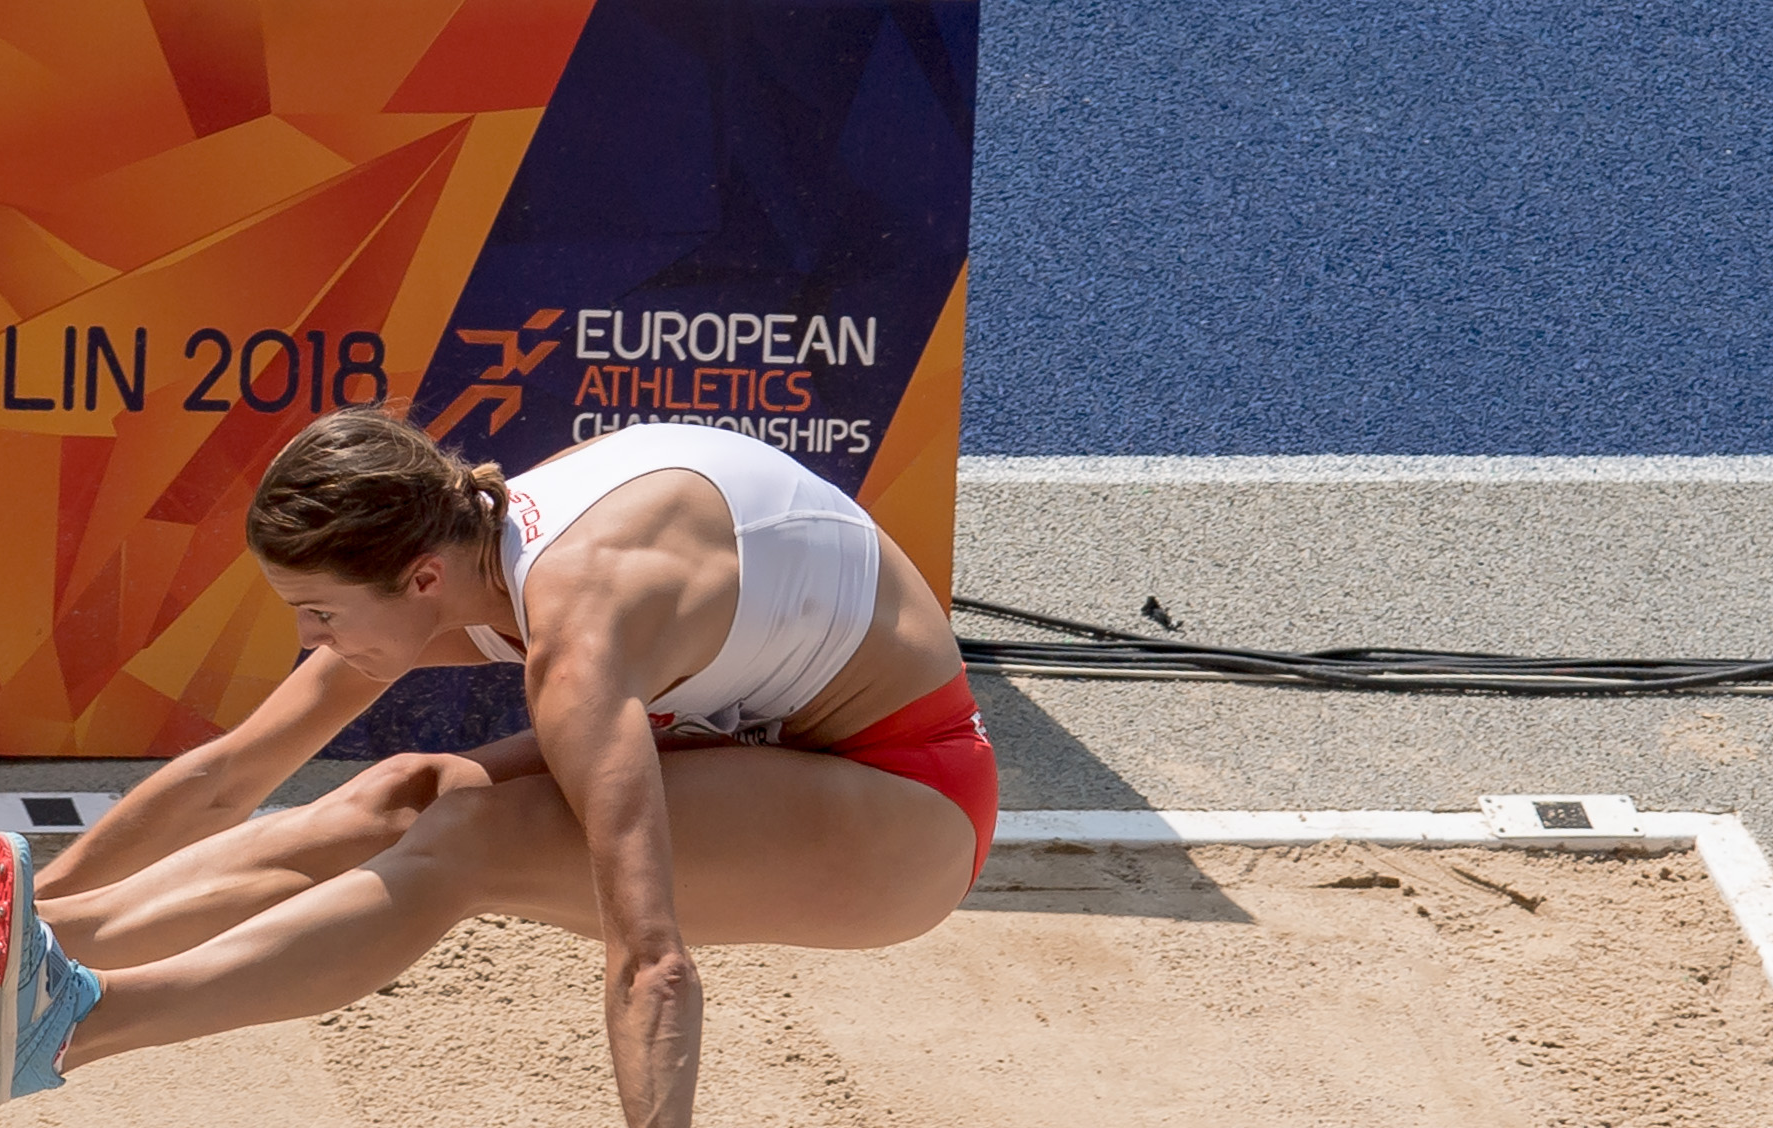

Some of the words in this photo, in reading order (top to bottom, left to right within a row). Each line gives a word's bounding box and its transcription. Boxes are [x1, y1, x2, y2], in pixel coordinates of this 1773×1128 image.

[576, 309, 876, 366] EUROPEAN
[183, 327, 389, 414] 2018
[574, 364, 812, 412] ATHLETICS
[572, 412, 871, 453] CHNSHIPS
[506, 488, 544, 544] POLS
